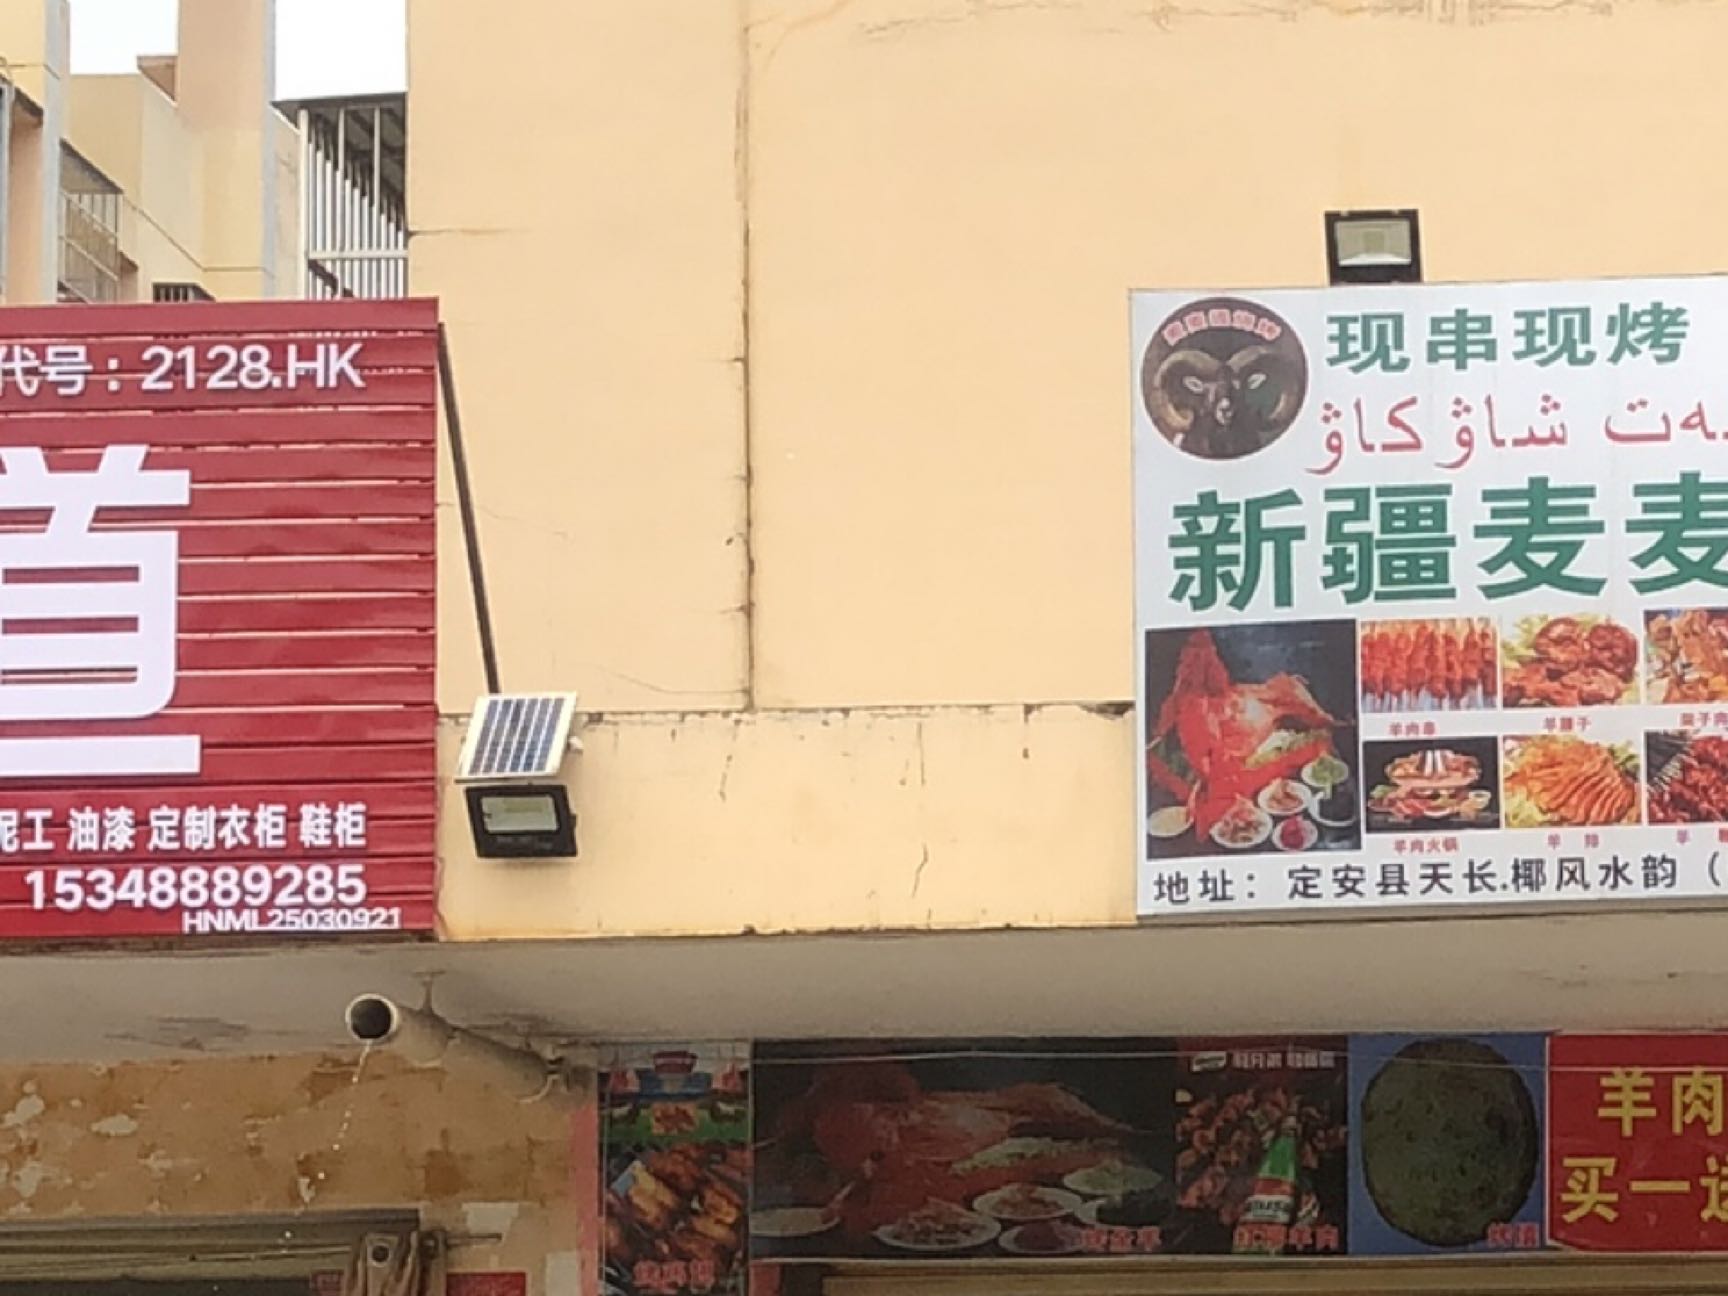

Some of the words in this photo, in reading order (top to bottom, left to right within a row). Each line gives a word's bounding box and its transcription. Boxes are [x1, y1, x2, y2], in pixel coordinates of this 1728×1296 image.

[1326, 300, 1690, 374] 现串现烤
[66, 806, 137, 852] 油漆
[148, 803, 288, 852] 定制衣柜
[299, 802, 367, 849] 鞋柜
[25, 863, 367, 912] 15348889285
[183, 906, 401, 934] HNML25030921
